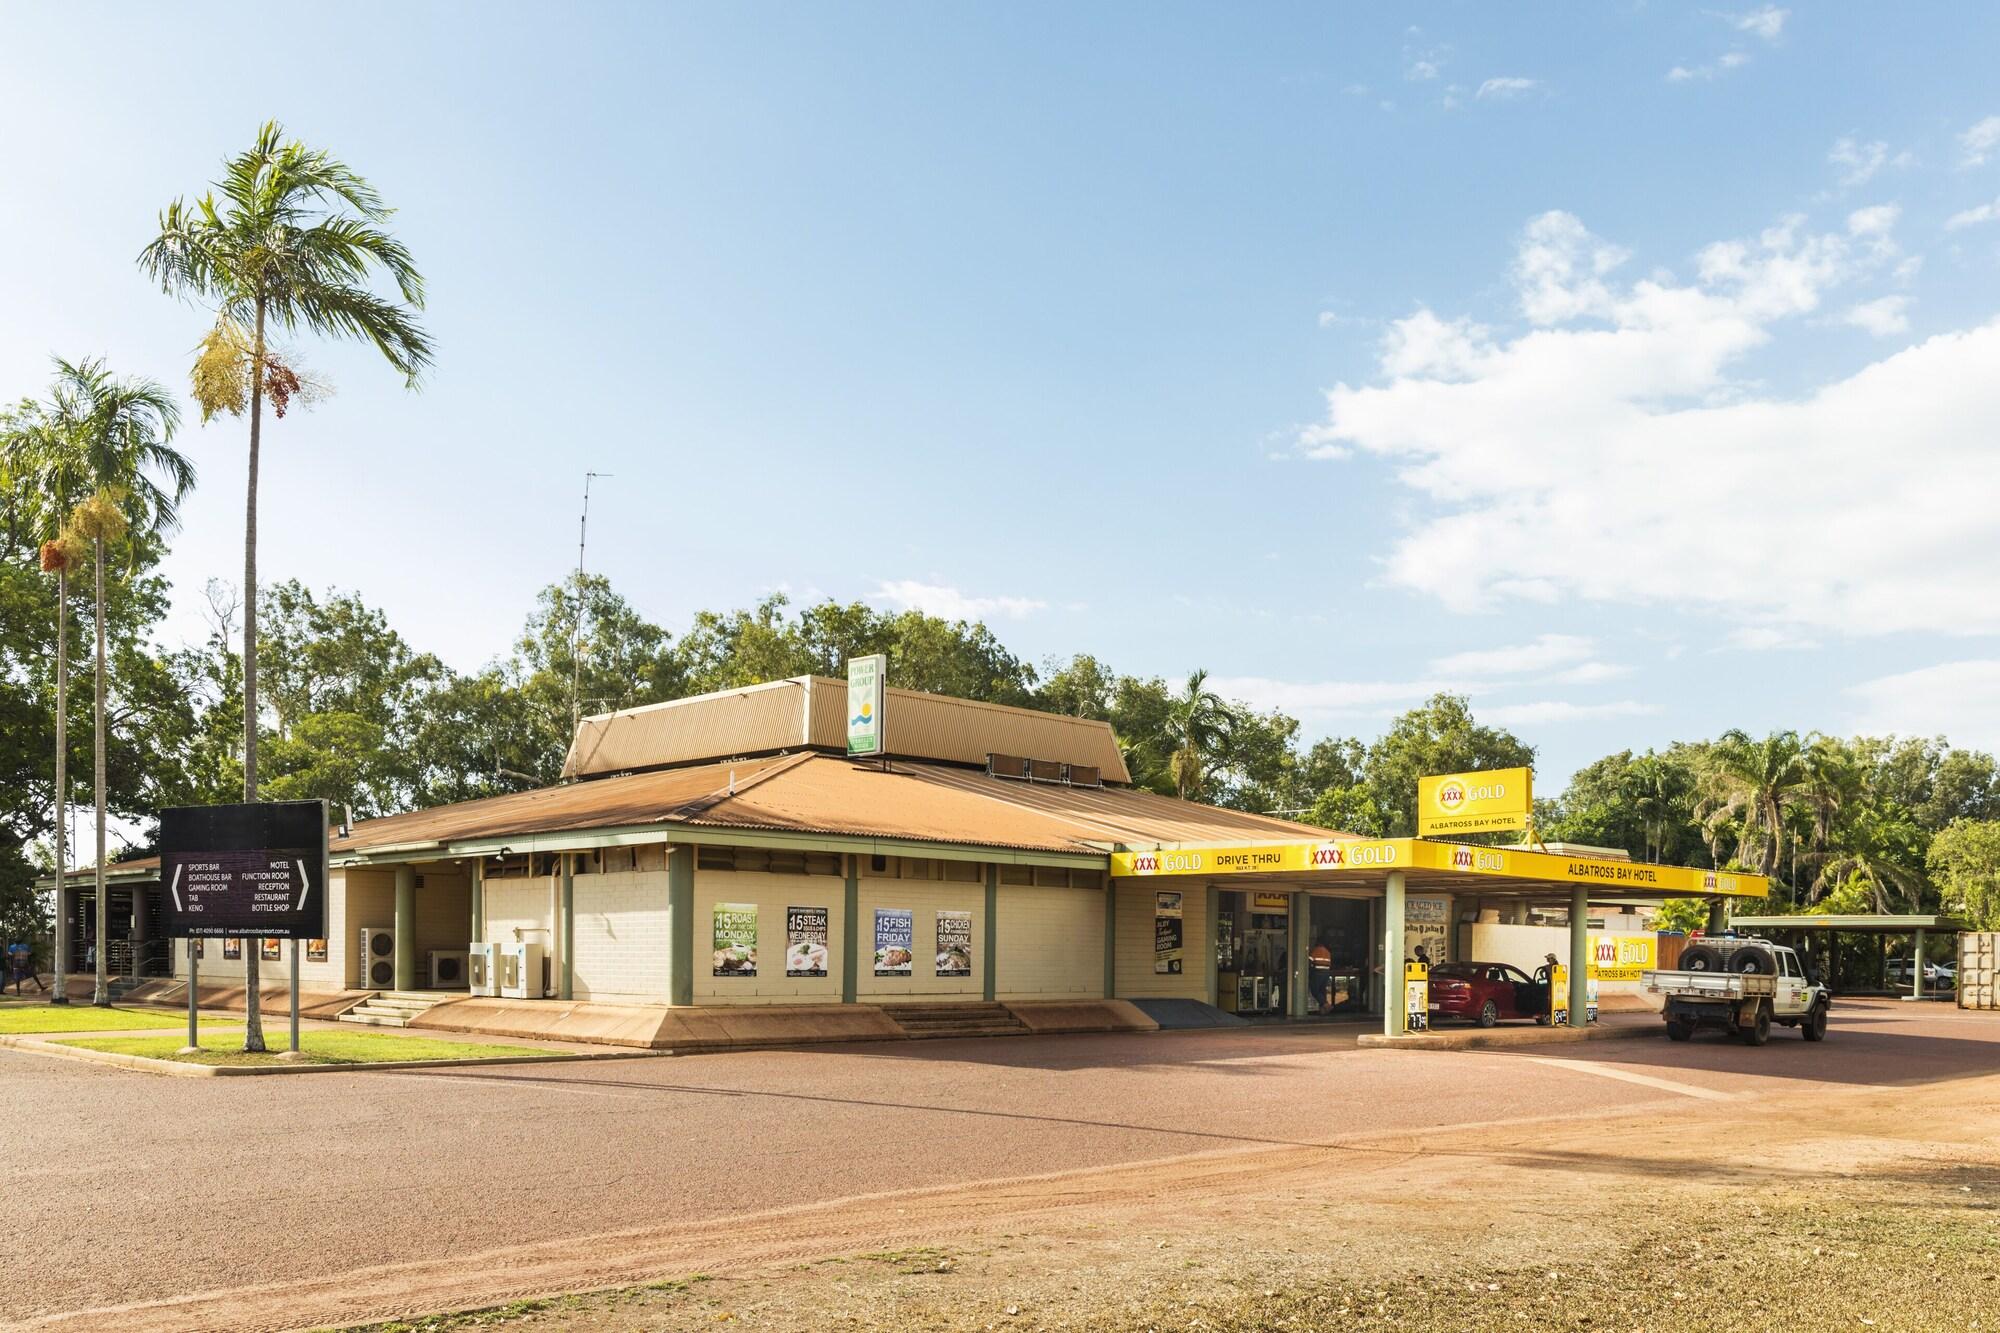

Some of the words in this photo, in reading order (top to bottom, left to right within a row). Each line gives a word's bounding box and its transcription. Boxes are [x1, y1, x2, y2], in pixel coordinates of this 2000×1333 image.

[1440, 791, 1465, 802] XXXX
[1467, 784, 1505, 801] GOLD
[1430, 820, 1473, 829] ALBATROSS
[1474, 819, 1490, 827] BAY
[1491, 817, 1516, 825] HOTEL
[1217, 855, 1249, 865] DRIVE
[1251, 853, 1281, 864] THRU
[1312, 850, 1345, 864] XXXX
[1350, 845, 1397, 865] GOLD
[270, 861, 290, 869] MOTEL
[1132, 858, 1161, 871] XXXX
[1164, 854, 1202, 871] GOLD
[1452, 851, 1474, 867] XXXX
[1476, 851, 1504, 871] GOLD
[188, 863, 209, 871] SPORTS
[209, 863, 220, 871] BAR
[241, 872, 271, 880] FUNCTION
[271, 872, 290, 880] ROOM
[1568, 863, 1615, 879] ALBATROSS
[1616, 866, 1632, 880] BAY
[1633, 867, 1657, 882] HOTEL
[258, 882, 290, 890] RECEPTION
[1718, 877, 1736, 891] GOLD
[254, 893, 290, 901] RESTAURANT
[188, 904, 204, 912] KENO
[273, 904, 290, 912] SHOP
[731, 913, 756, 923] ROAST
[803, 916, 826, 925] STEAK
[890, 918, 911, 927] FISH
[950, 920, 970, 929] CHICKEN
[716, 930, 755, 940] MONDAY
[789, 931, 826, 940] WEDNESDAY
[877, 933, 910, 942] FRIDAY
[1594, 944, 1617, 961] XXXX
[1620, 942, 1649, 964] GOLD
[1619, 970, 1630, 978] BAY
